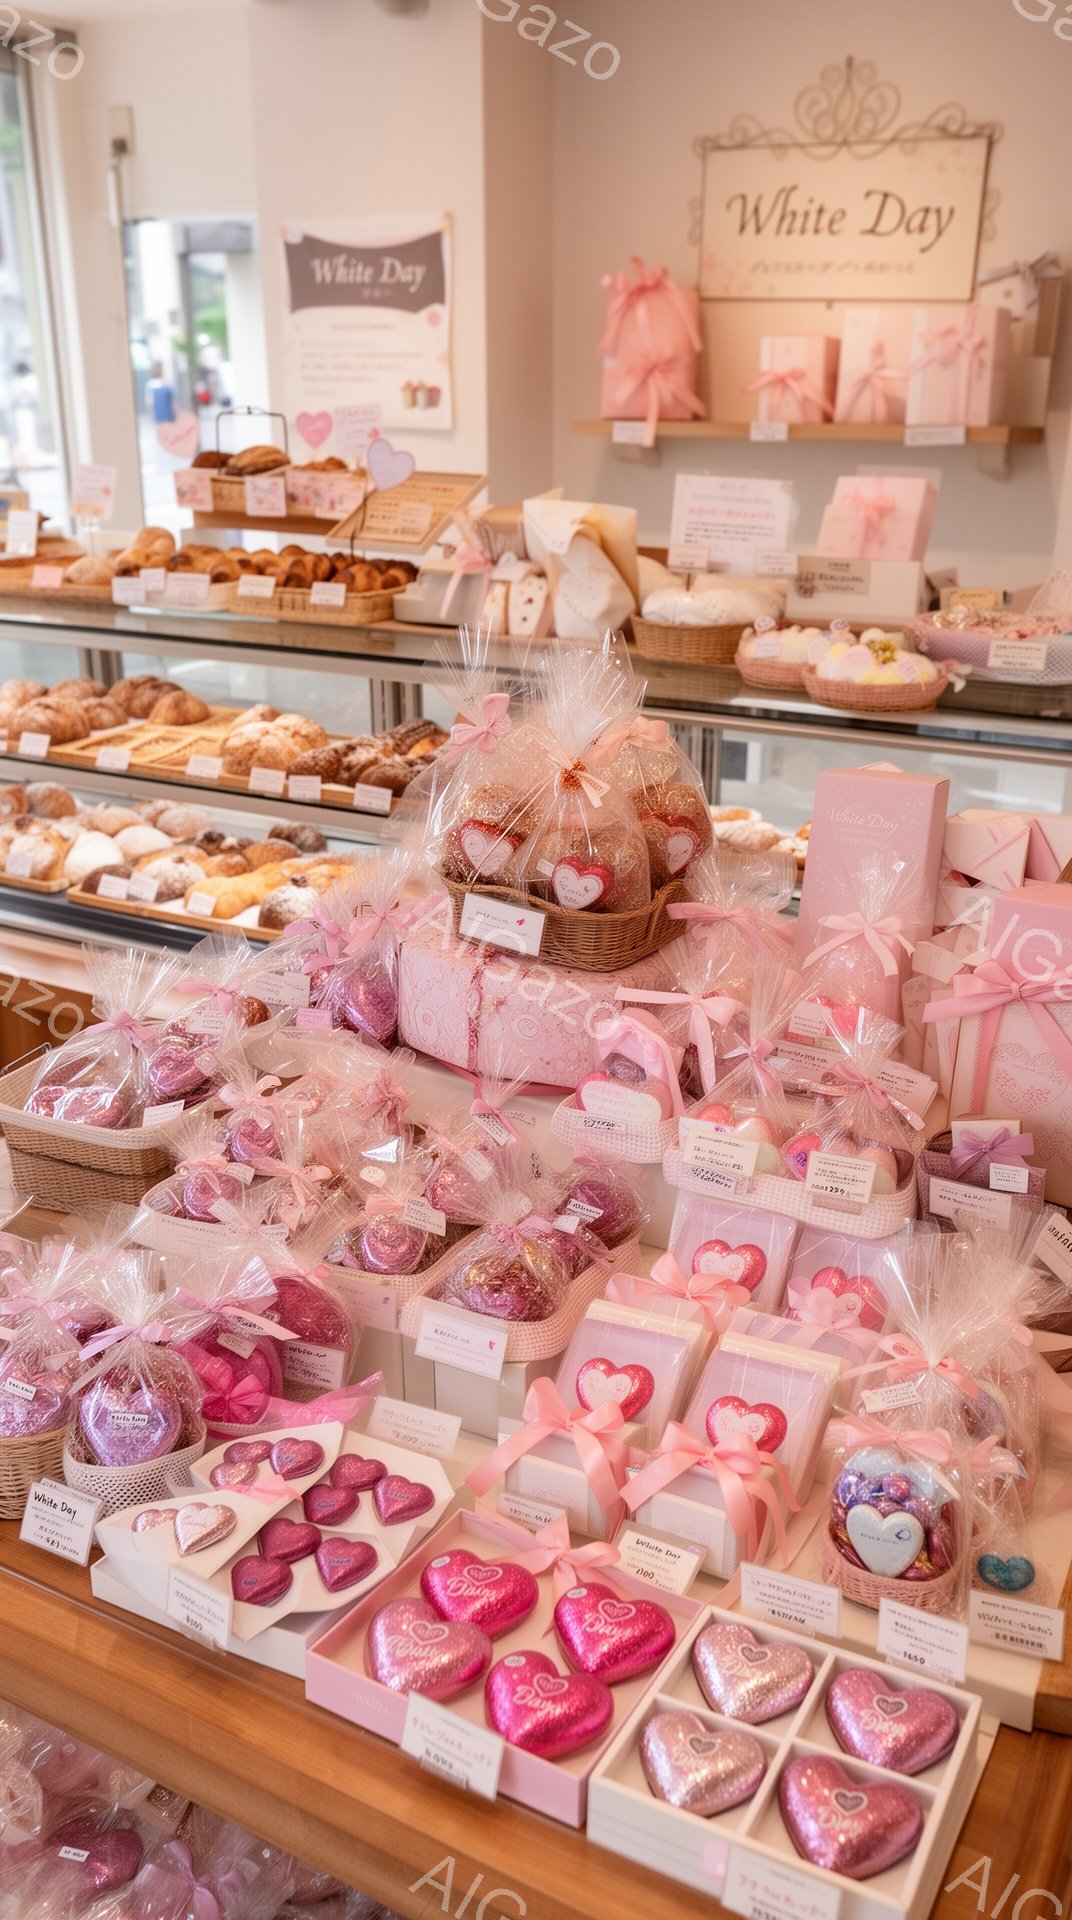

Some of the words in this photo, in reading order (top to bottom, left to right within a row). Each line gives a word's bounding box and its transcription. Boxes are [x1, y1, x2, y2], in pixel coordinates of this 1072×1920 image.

[725, 184, 847, 236] White
[860, 189, 955, 253] Day
[311, 254, 375, 285] White
[379, 257, 427, 293] Day
[827, 808, 865, 826] White
[867, 813, 898, 836] Day
[34, 1491, 59, 1510] White
[61, 1502, 78, 1521] Day
